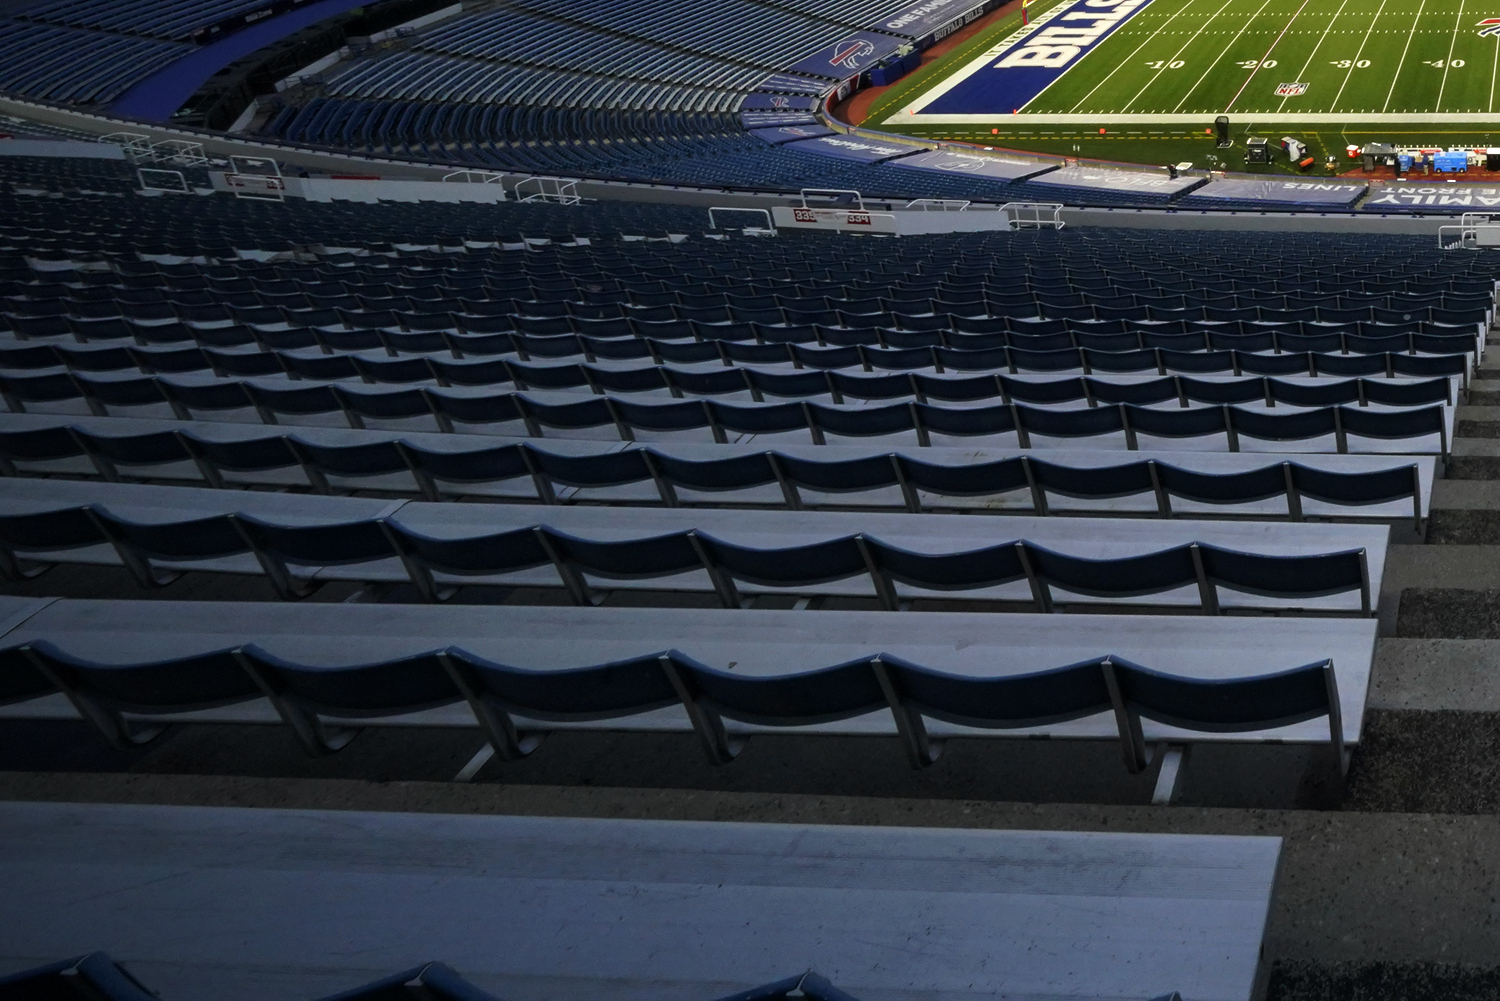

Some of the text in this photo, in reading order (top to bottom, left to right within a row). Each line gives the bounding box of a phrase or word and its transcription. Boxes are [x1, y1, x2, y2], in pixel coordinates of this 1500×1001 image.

[886, 6, 917, 29] ONE
[934, 18, 964, 42] BUFFALO
[964, 6, 984, 24] BILLS
[818, 136, 903, 156] Tim Hortons
[1282, 182, 1358, 192] LINES
[1380, 186, 1466, 195] FRONT
